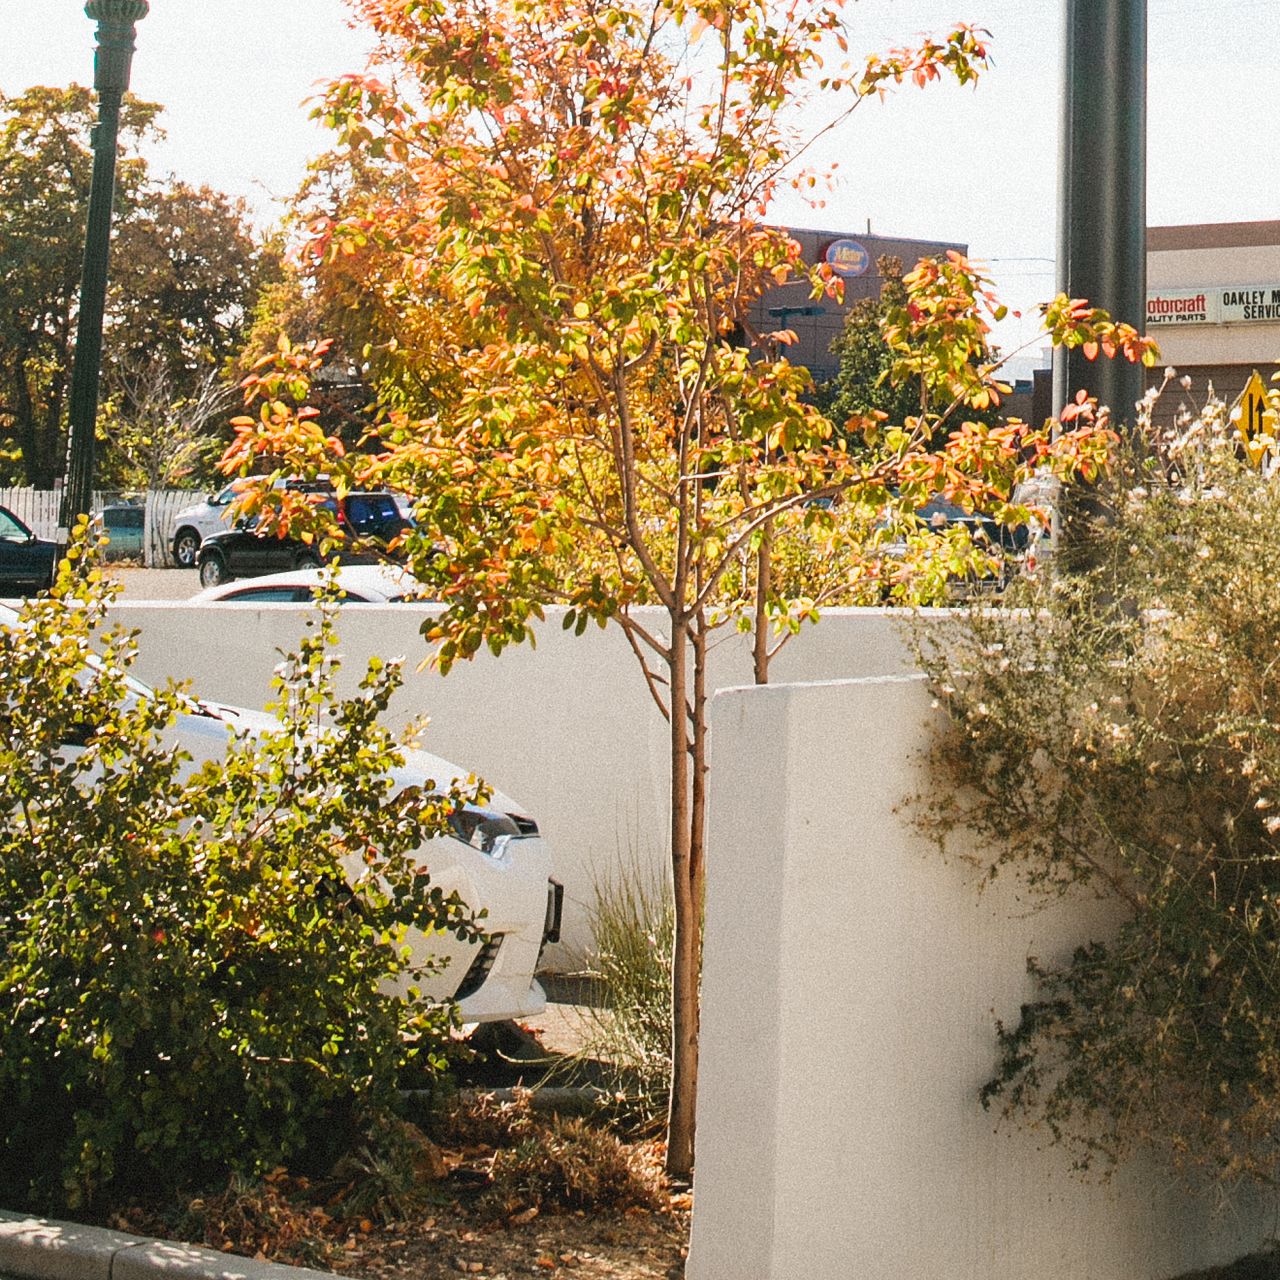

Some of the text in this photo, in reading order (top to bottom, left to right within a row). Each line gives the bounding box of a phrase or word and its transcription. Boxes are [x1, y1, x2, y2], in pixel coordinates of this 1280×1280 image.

[1147, 294, 1206, 314] otorcraft
[1223, 290, 1265, 306] OAKLEY
[1146, 313, 1206, 323] ALITY PARTS
